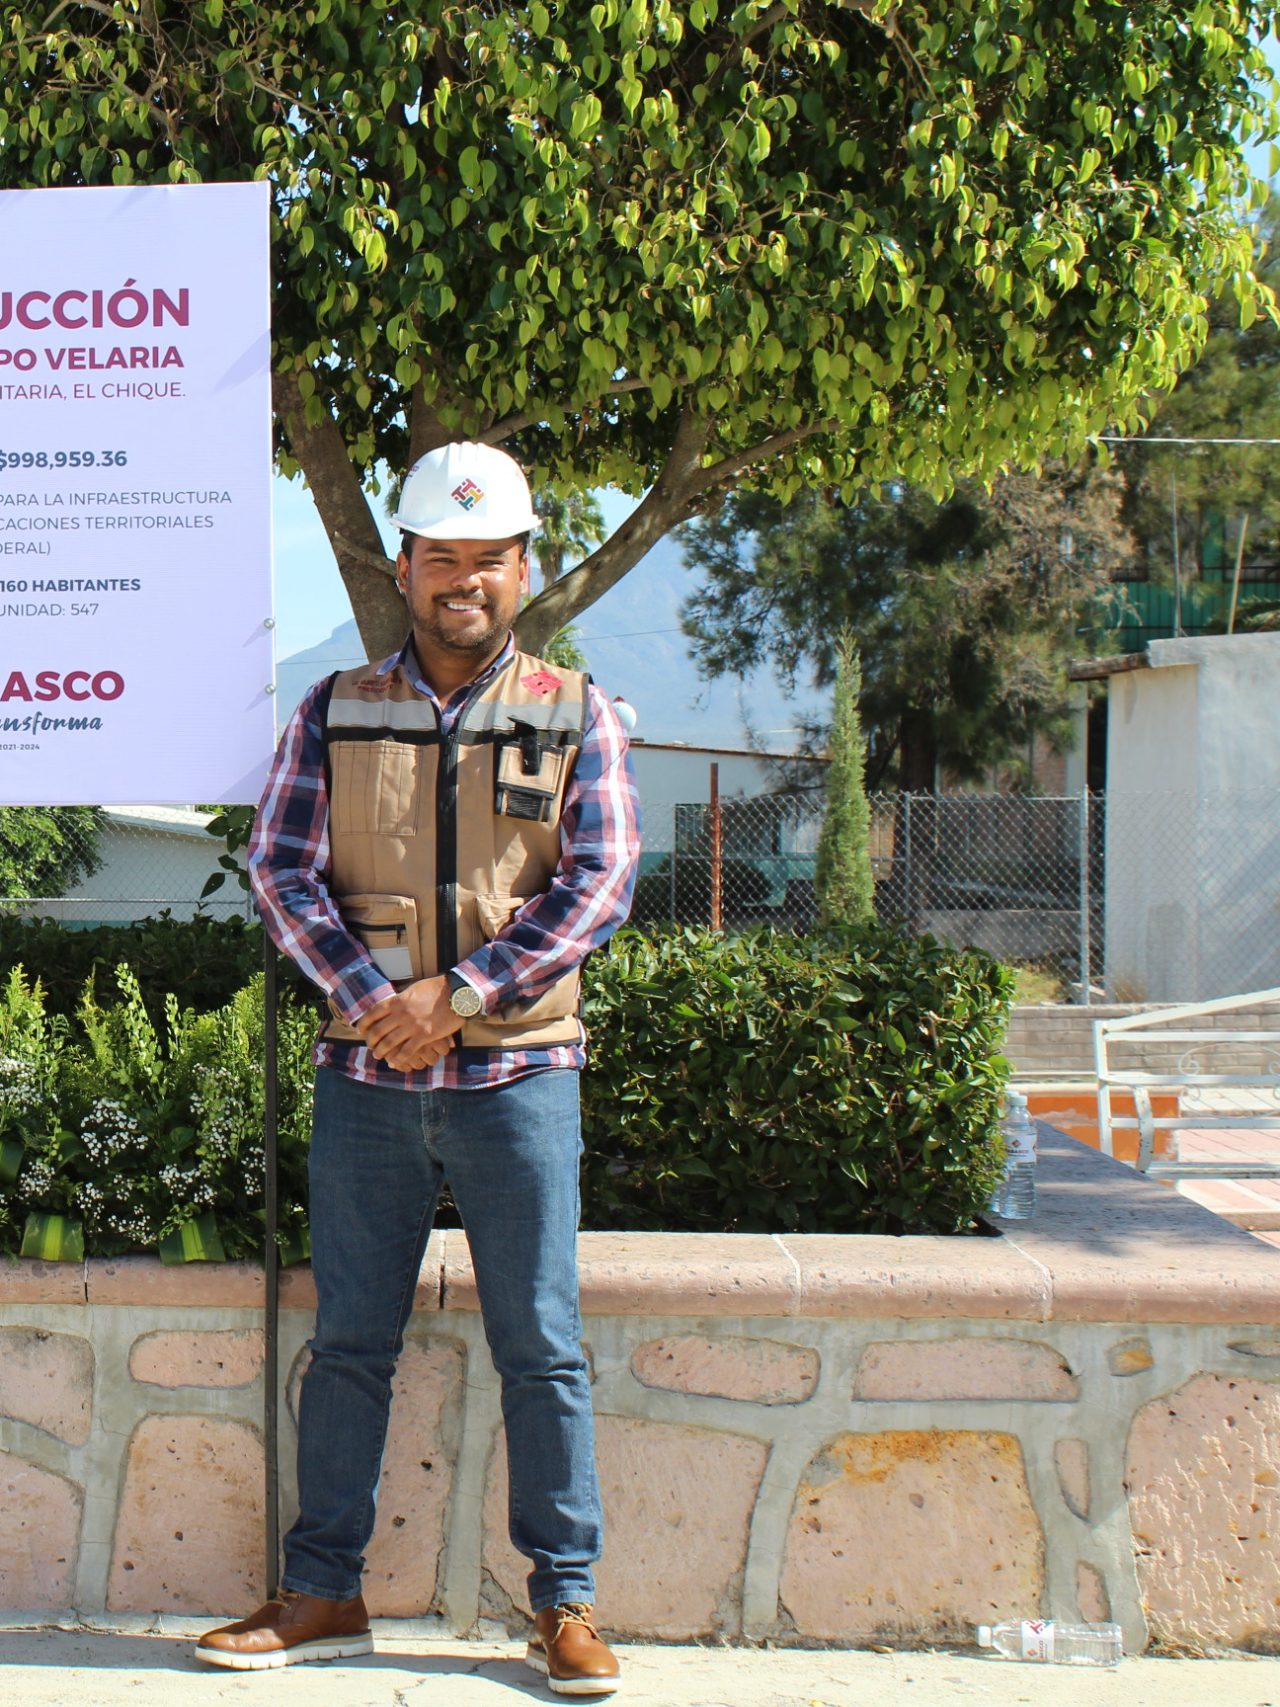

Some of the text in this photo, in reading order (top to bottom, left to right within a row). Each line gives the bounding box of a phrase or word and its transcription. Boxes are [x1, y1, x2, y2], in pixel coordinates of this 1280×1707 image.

[44, 346, 184, 370] VELARIA
[74, 384, 96, 398] EL
[102, 382, 185, 400] CHIQUE.
[45, 494, 64, 505] LA
[70, 491, 232, 505] INFRAESTRUCTURA
[85, 516, 213, 529] TERRITORIALES
[32, 578, 141, 592] HABITANTES
[71, 603, 99, 616] 547
